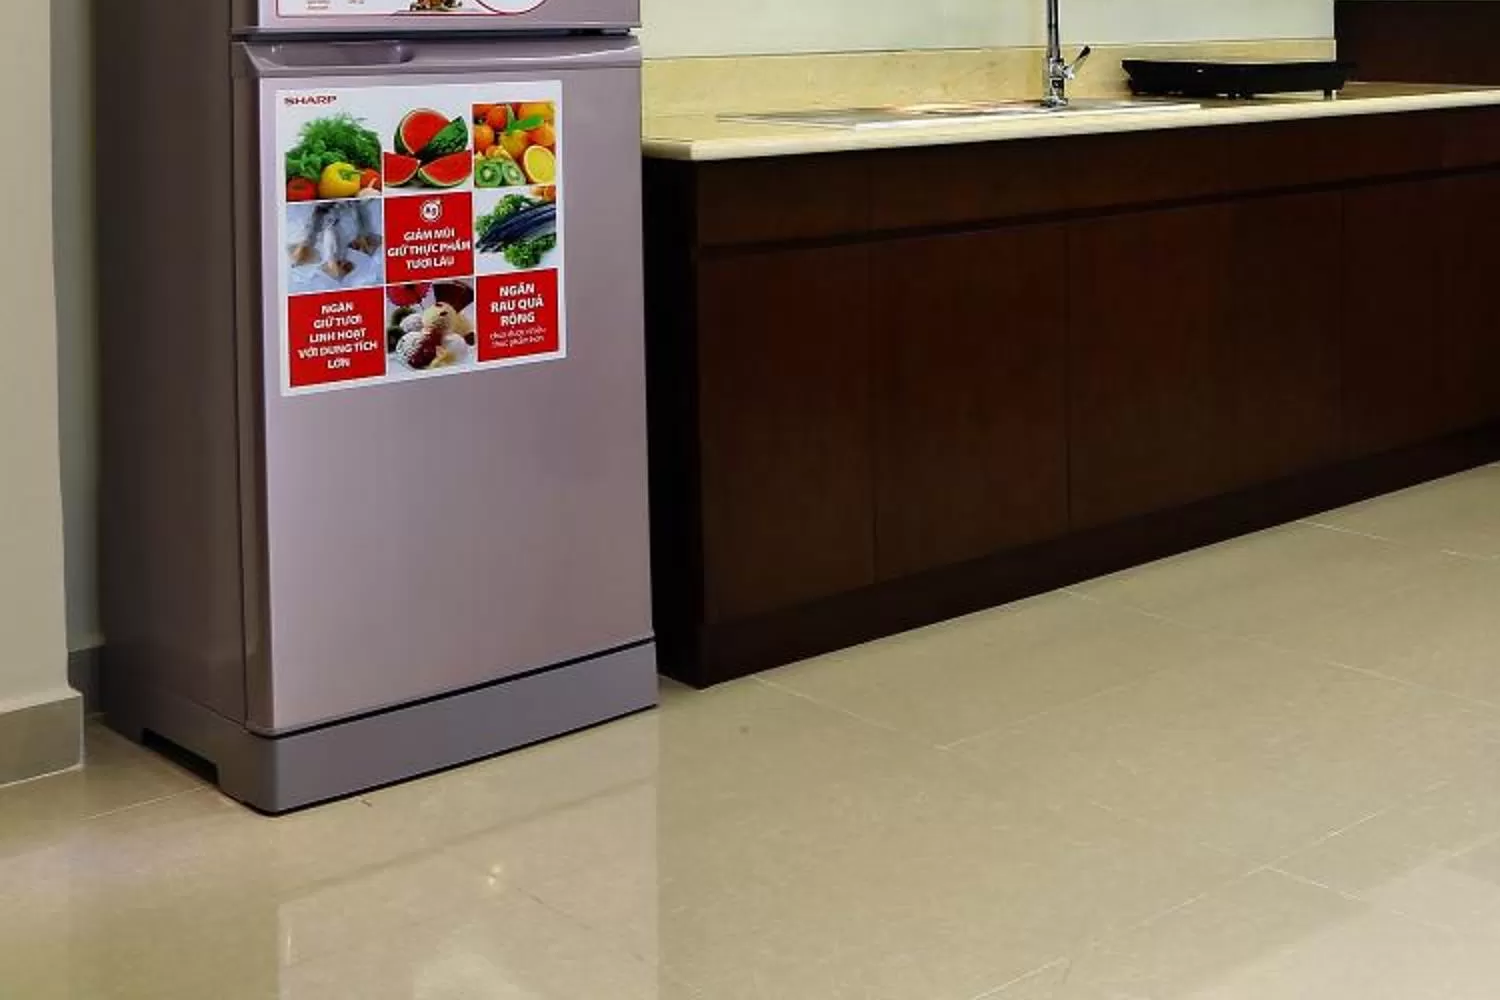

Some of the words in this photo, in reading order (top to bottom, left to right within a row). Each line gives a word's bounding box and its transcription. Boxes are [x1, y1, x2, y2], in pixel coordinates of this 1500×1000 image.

[283, 95, 337, 105] SHARP
[490, 300, 516, 313] RAU
[518, 293, 545, 310] QUẢ
[309, 331, 336, 343] LINH
[337, 327, 367, 340] HOẠT
[320, 343, 353, 357] DUNG
